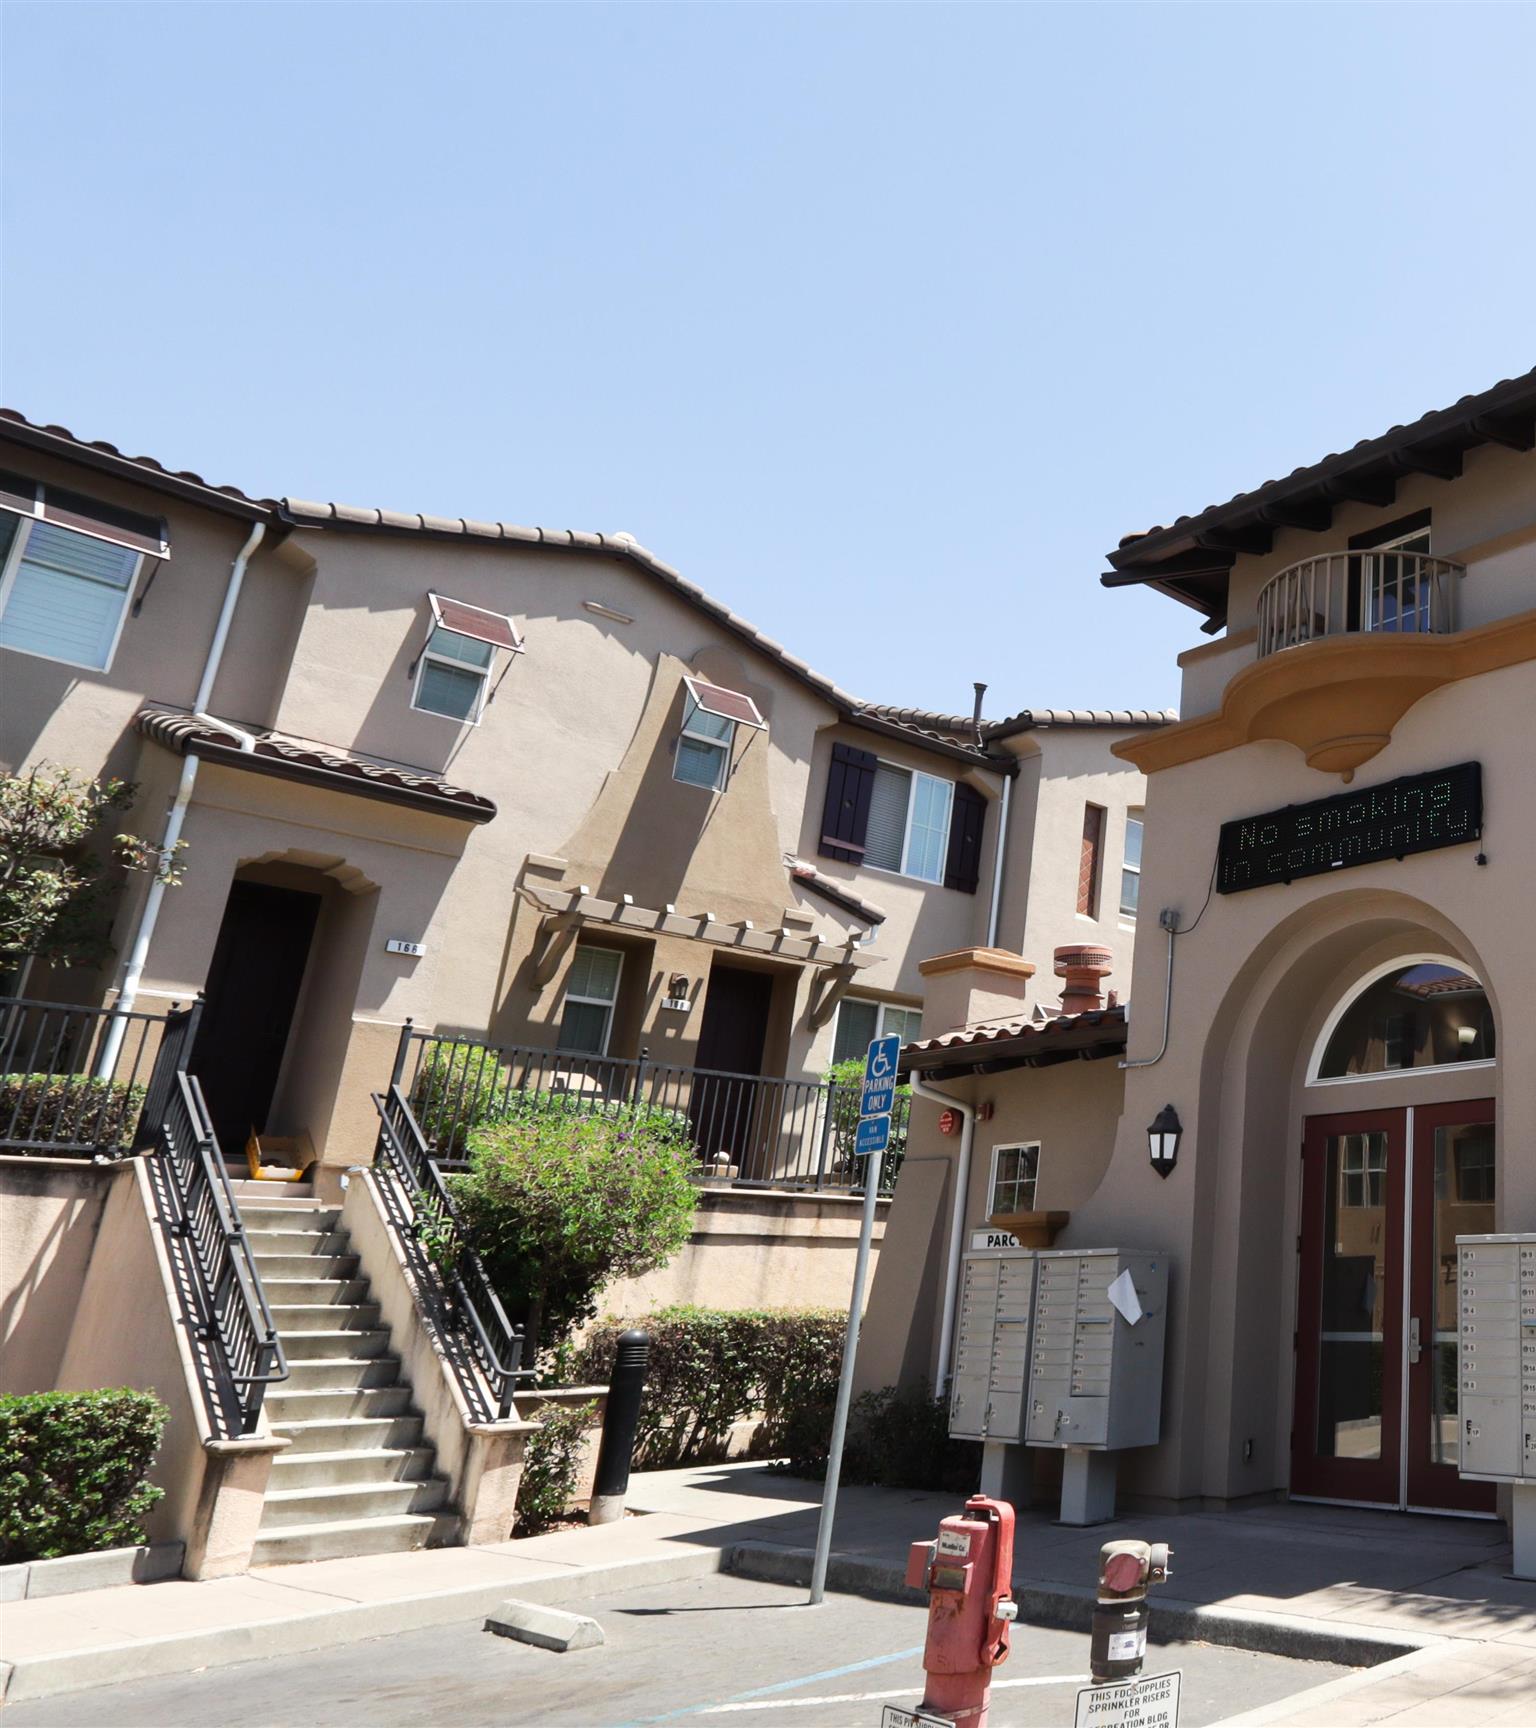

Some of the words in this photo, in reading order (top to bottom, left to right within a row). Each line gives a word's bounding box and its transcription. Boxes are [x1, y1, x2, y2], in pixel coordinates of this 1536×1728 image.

[1240, 822, 1278, 850] No
[1295, 781, 1451, 837] smoking
[1224, 857, 1251, 884] in
[1267, 809, 1468, 873] community
[397, 942, 418, 954] 166
[864, 1075, 895, 1094] PARKING
[867, 1094, 887, 1111] ONLY
[987, 1233, 1016, 1247] PARC
[1090, 1691, 1111, 1702] THIS
[1114, 1688, 1132, 1698] FDC
[1134, 1679, 1171, 1695] SUPPLIES
[1088, 1697, 1140, 1713] SPRINKLER
[1142, 1690, 1170, 1703] RISERS
[890, 1712, 902, 1724] THIS
[1123, 1708, 1140, 1719] FOR
[1147, 1712, 1168, 1724] BLDG
